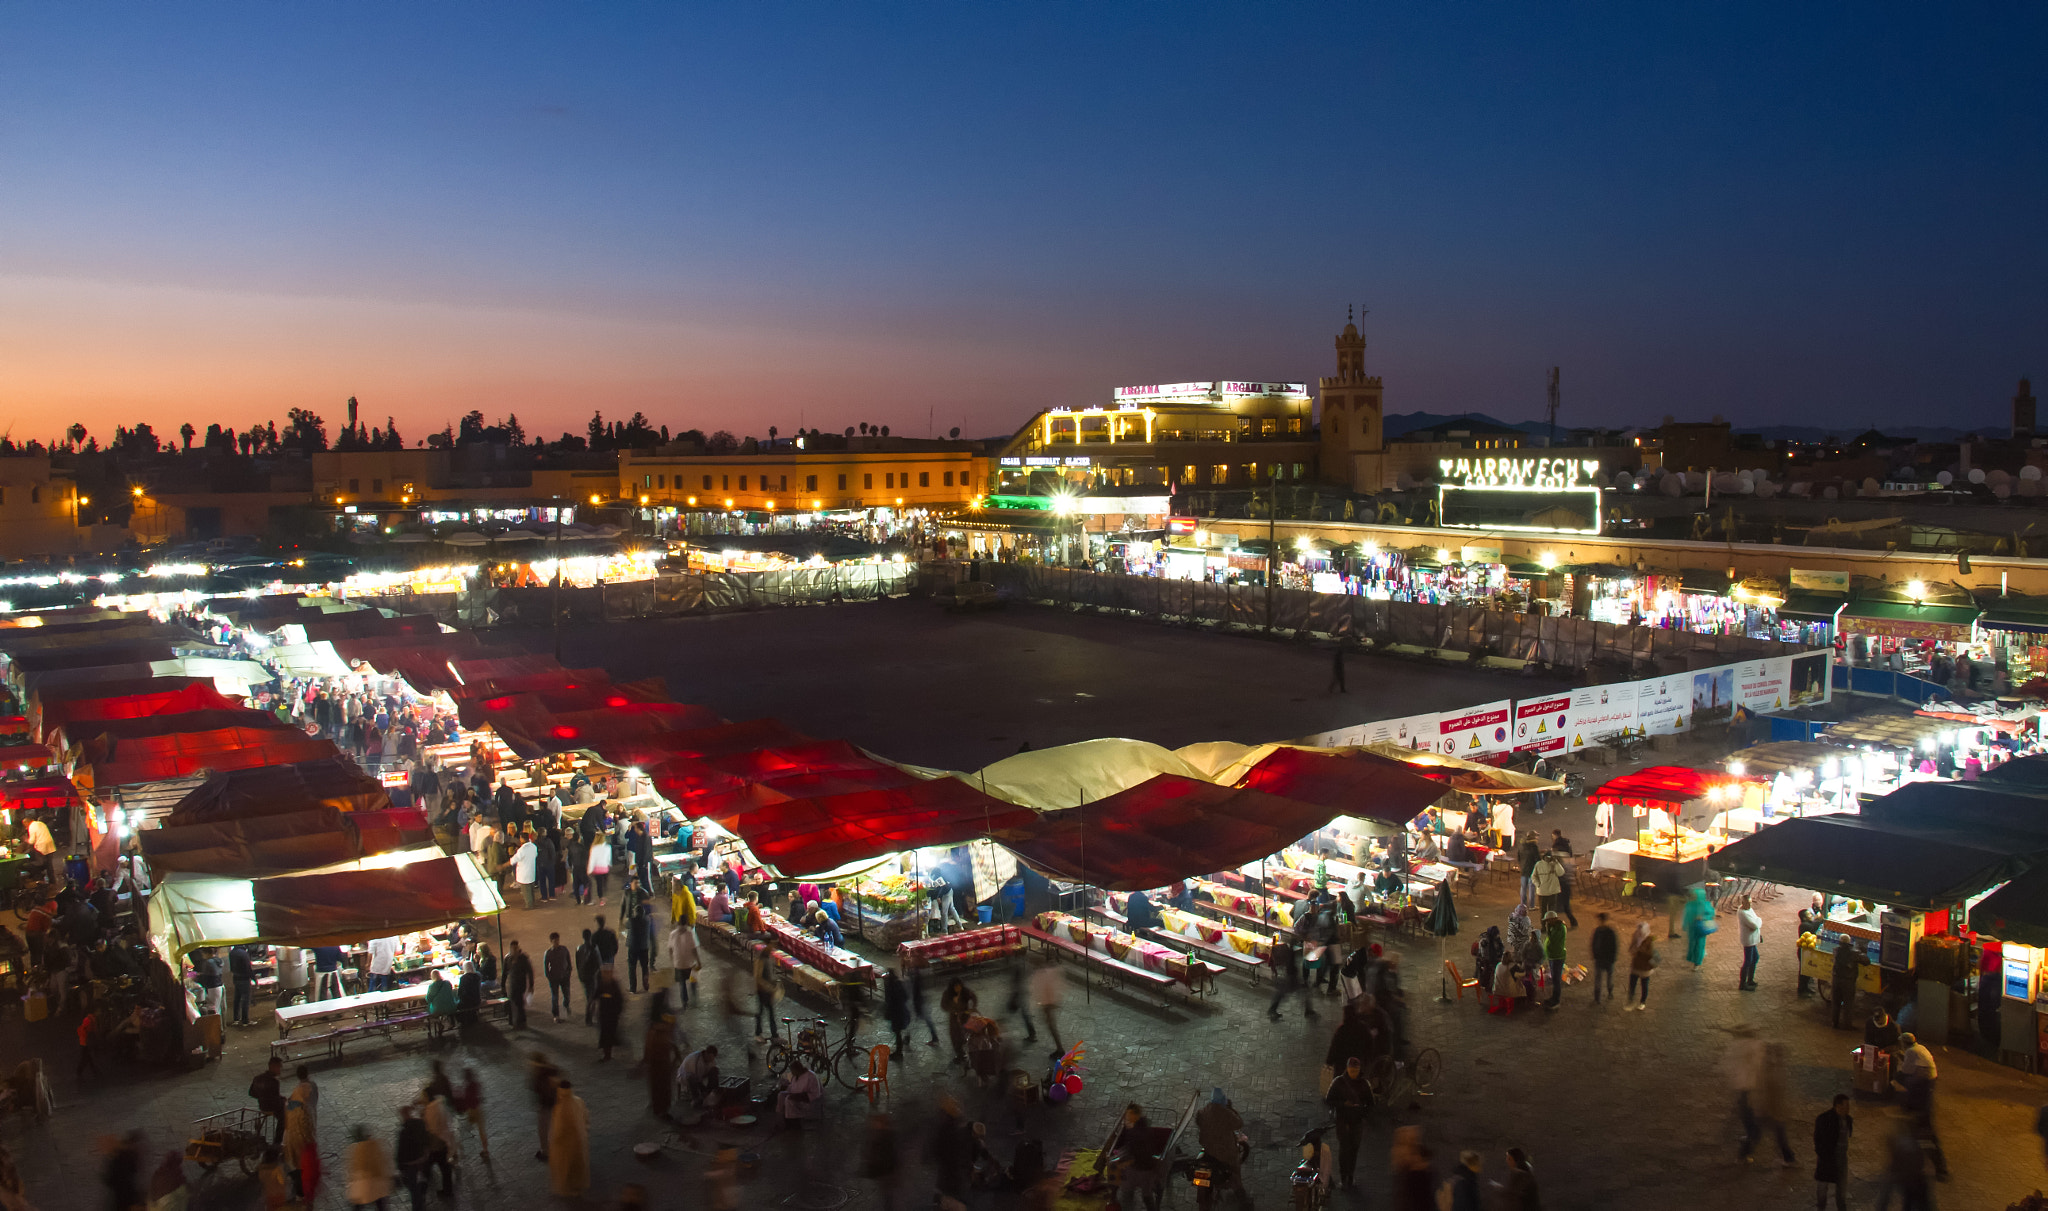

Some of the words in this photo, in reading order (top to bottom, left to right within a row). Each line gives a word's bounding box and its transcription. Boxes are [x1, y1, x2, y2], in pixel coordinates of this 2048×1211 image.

[1121, 385, 1160, 396] ARGANA
[1226, 382, 1263, 393] ARGANA
[1453, 458, 1578, 480] MARRAKECH
[1543, 703, 1554, 711] الدخول
[1463, 719, 1471, 727] على
[1472, 716, 1486, 725] الدخول
[1487, 714, 1500, 723] ممنوع
[1448, 720, 1462, 731] العموم
